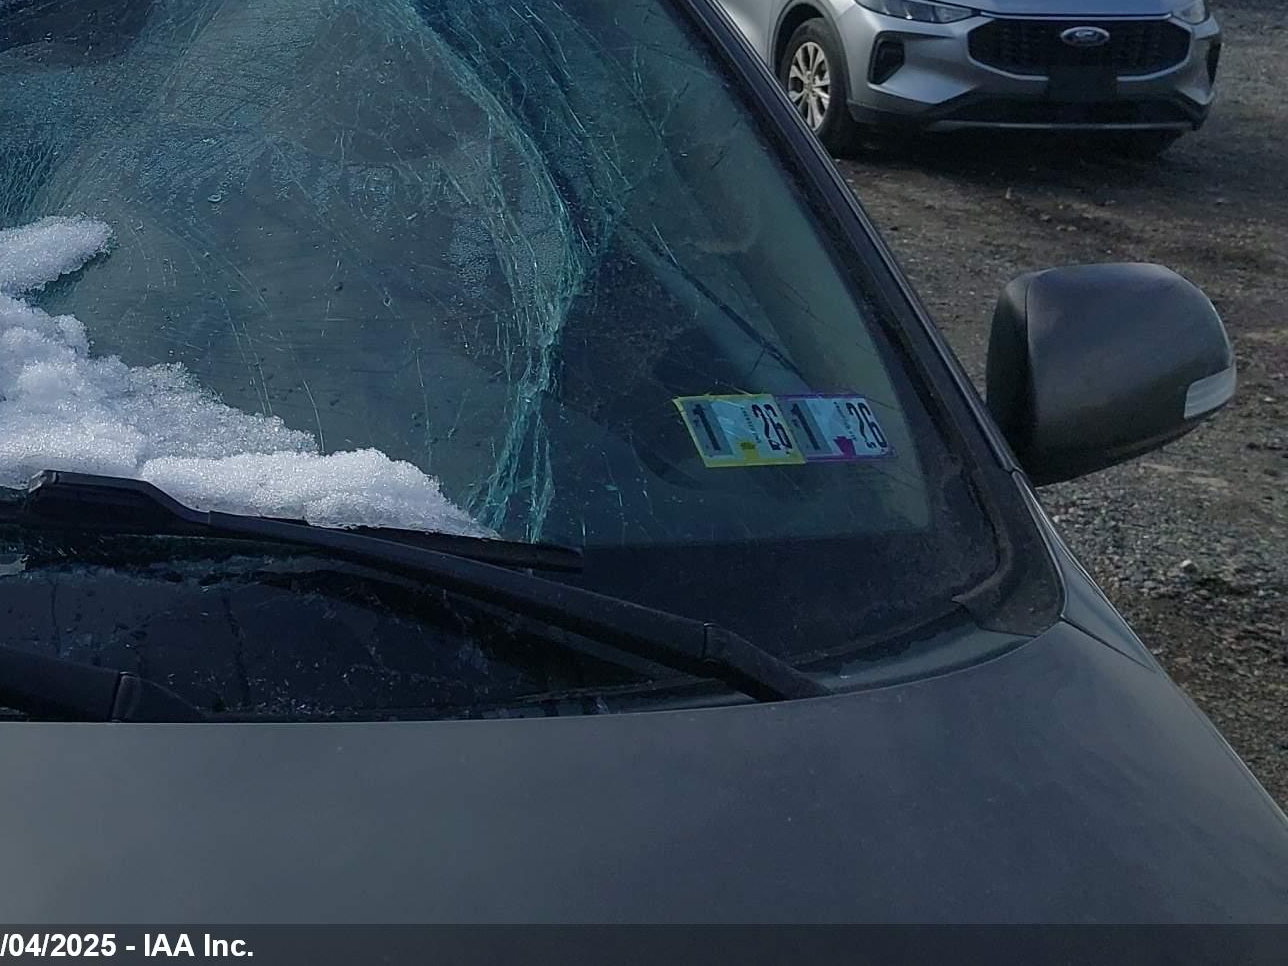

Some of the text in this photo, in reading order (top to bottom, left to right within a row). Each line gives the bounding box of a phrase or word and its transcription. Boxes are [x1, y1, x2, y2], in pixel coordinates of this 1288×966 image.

[693, 403, 722, 451] 1
[751, 403, 793, 450] 26
[791, 403, 821, 450] 1
[846, 402, 888, 448] 26
